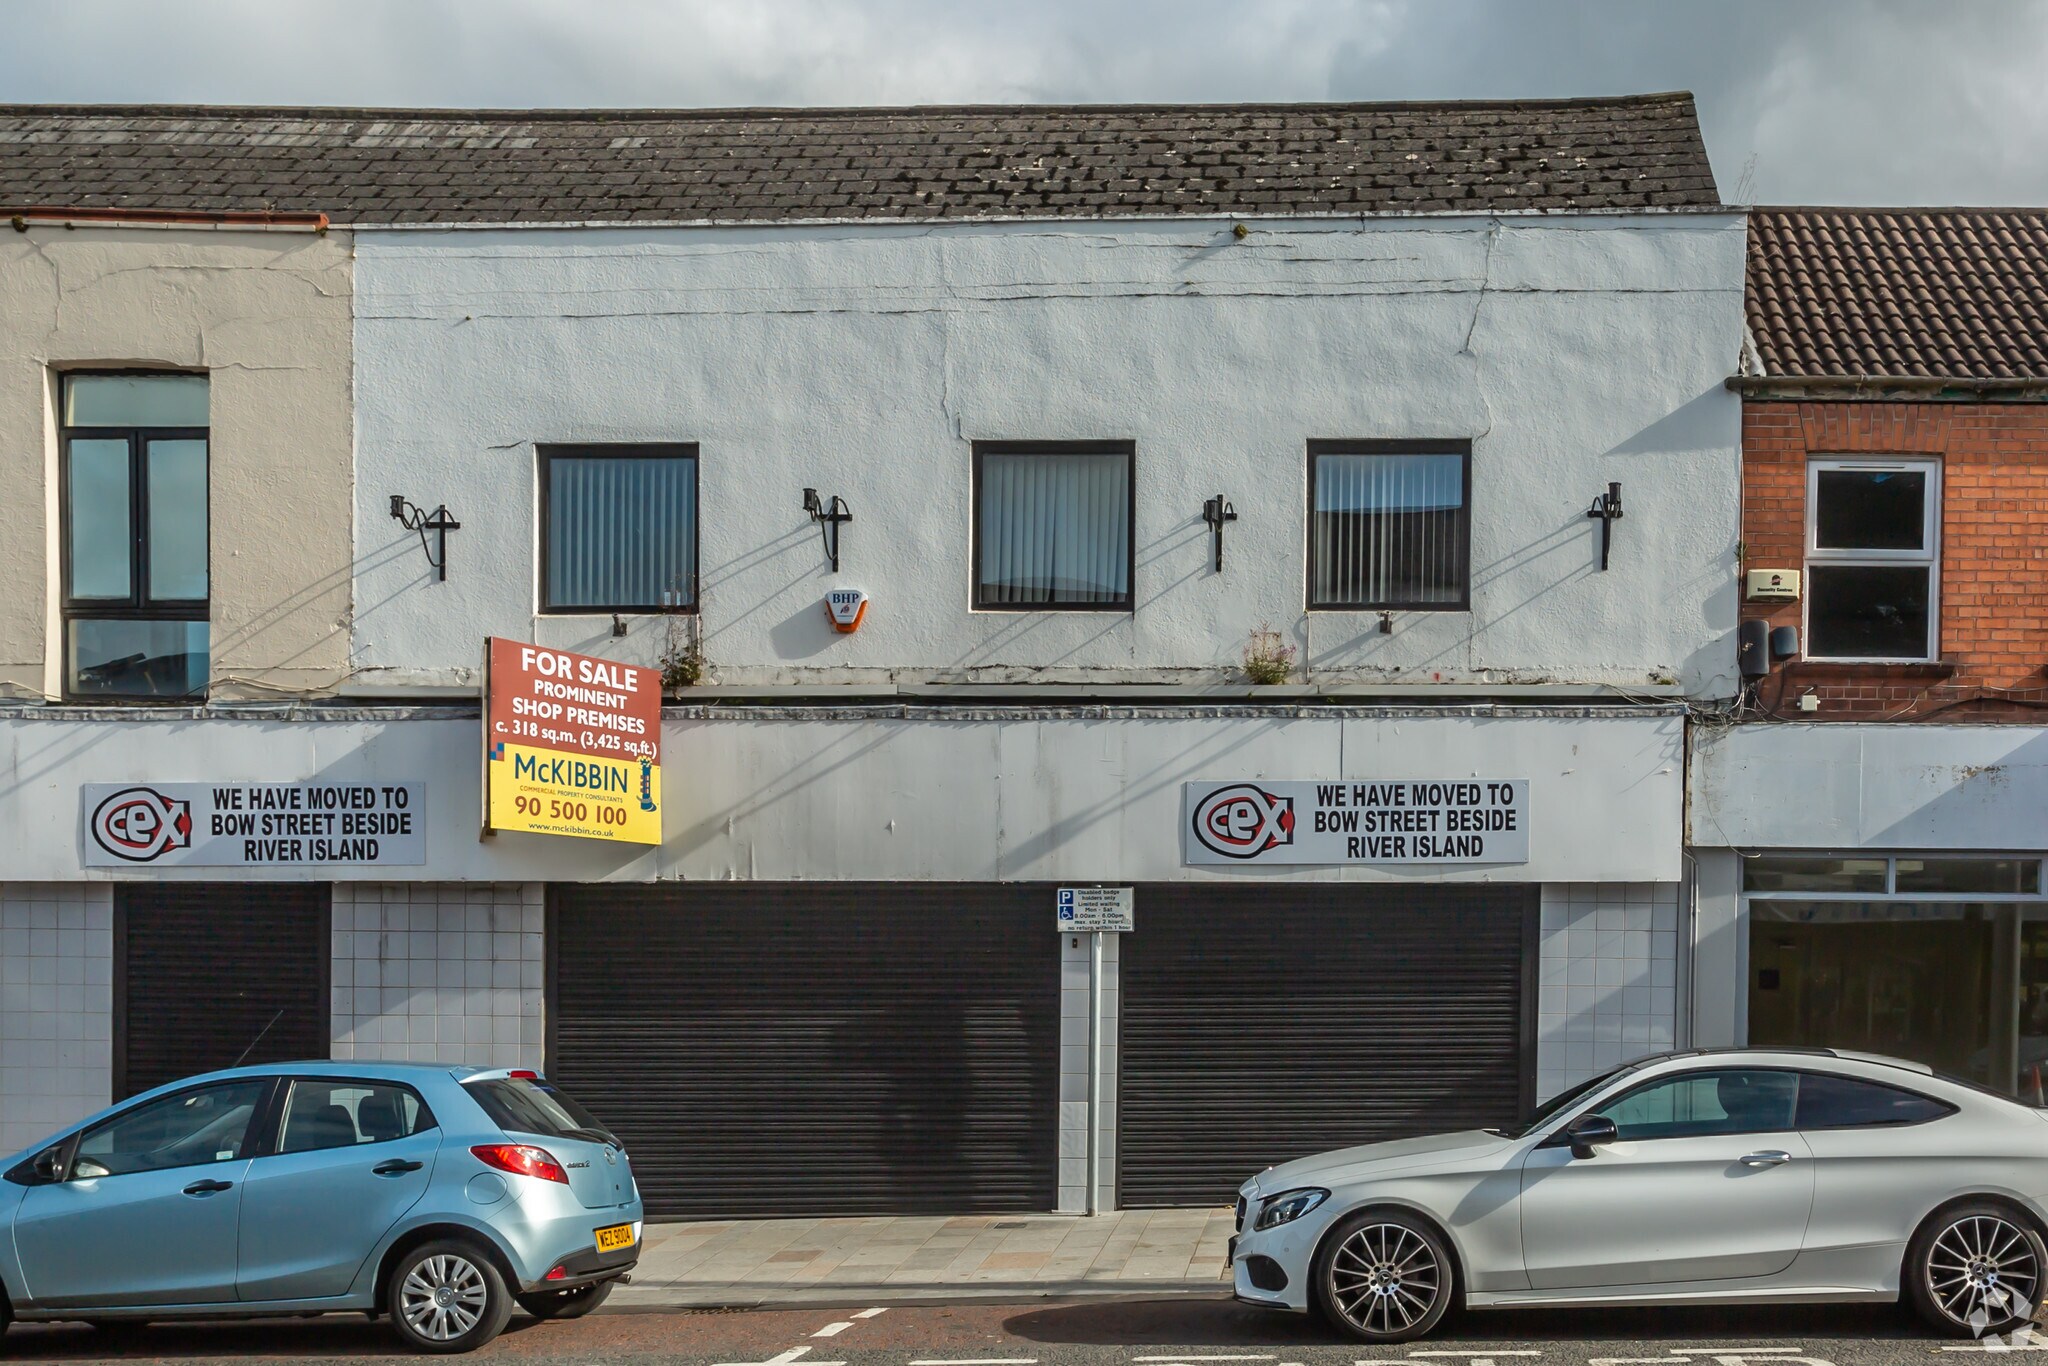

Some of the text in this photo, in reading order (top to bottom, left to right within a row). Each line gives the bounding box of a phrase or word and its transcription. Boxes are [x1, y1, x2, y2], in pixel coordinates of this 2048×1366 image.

[833, 593, 859, 603] BHP
[522, 648, 638, 692] FOR SALE
[534, 680, 627, 710] PROMINENT
[512, 697, 645, 734] SHOP PREMISES
[496, 720, 657, 759] c. 318 sq.m. (3,425 sq.ft.)
[514, 752, 628, 793] McKIBBIN
[212, 787, 408, 810] WE HAVE MOVED TO
[520, 785, 623, 804] COMMERCIAL PROPERTY CONSULTANTS
[1317, 783, 1514, 806] WE HAVE MOVED TO
[514, 796, 626, 826] 90 500 100
[1314, 810, 1516, 832] BOW STREET BESIDE
[212, 813, 412, 836] BOW STREET BESIDE
[528, 823, 614, 838] www.mckibbin.co.uk
[244, 839, 379, 862] RIVER ISLAND
[1347, 836, 1483, 858] RIVER ISLAND
[1062, 892, 1071, 903] P
[614, 1227, 630, 1245] 9004
